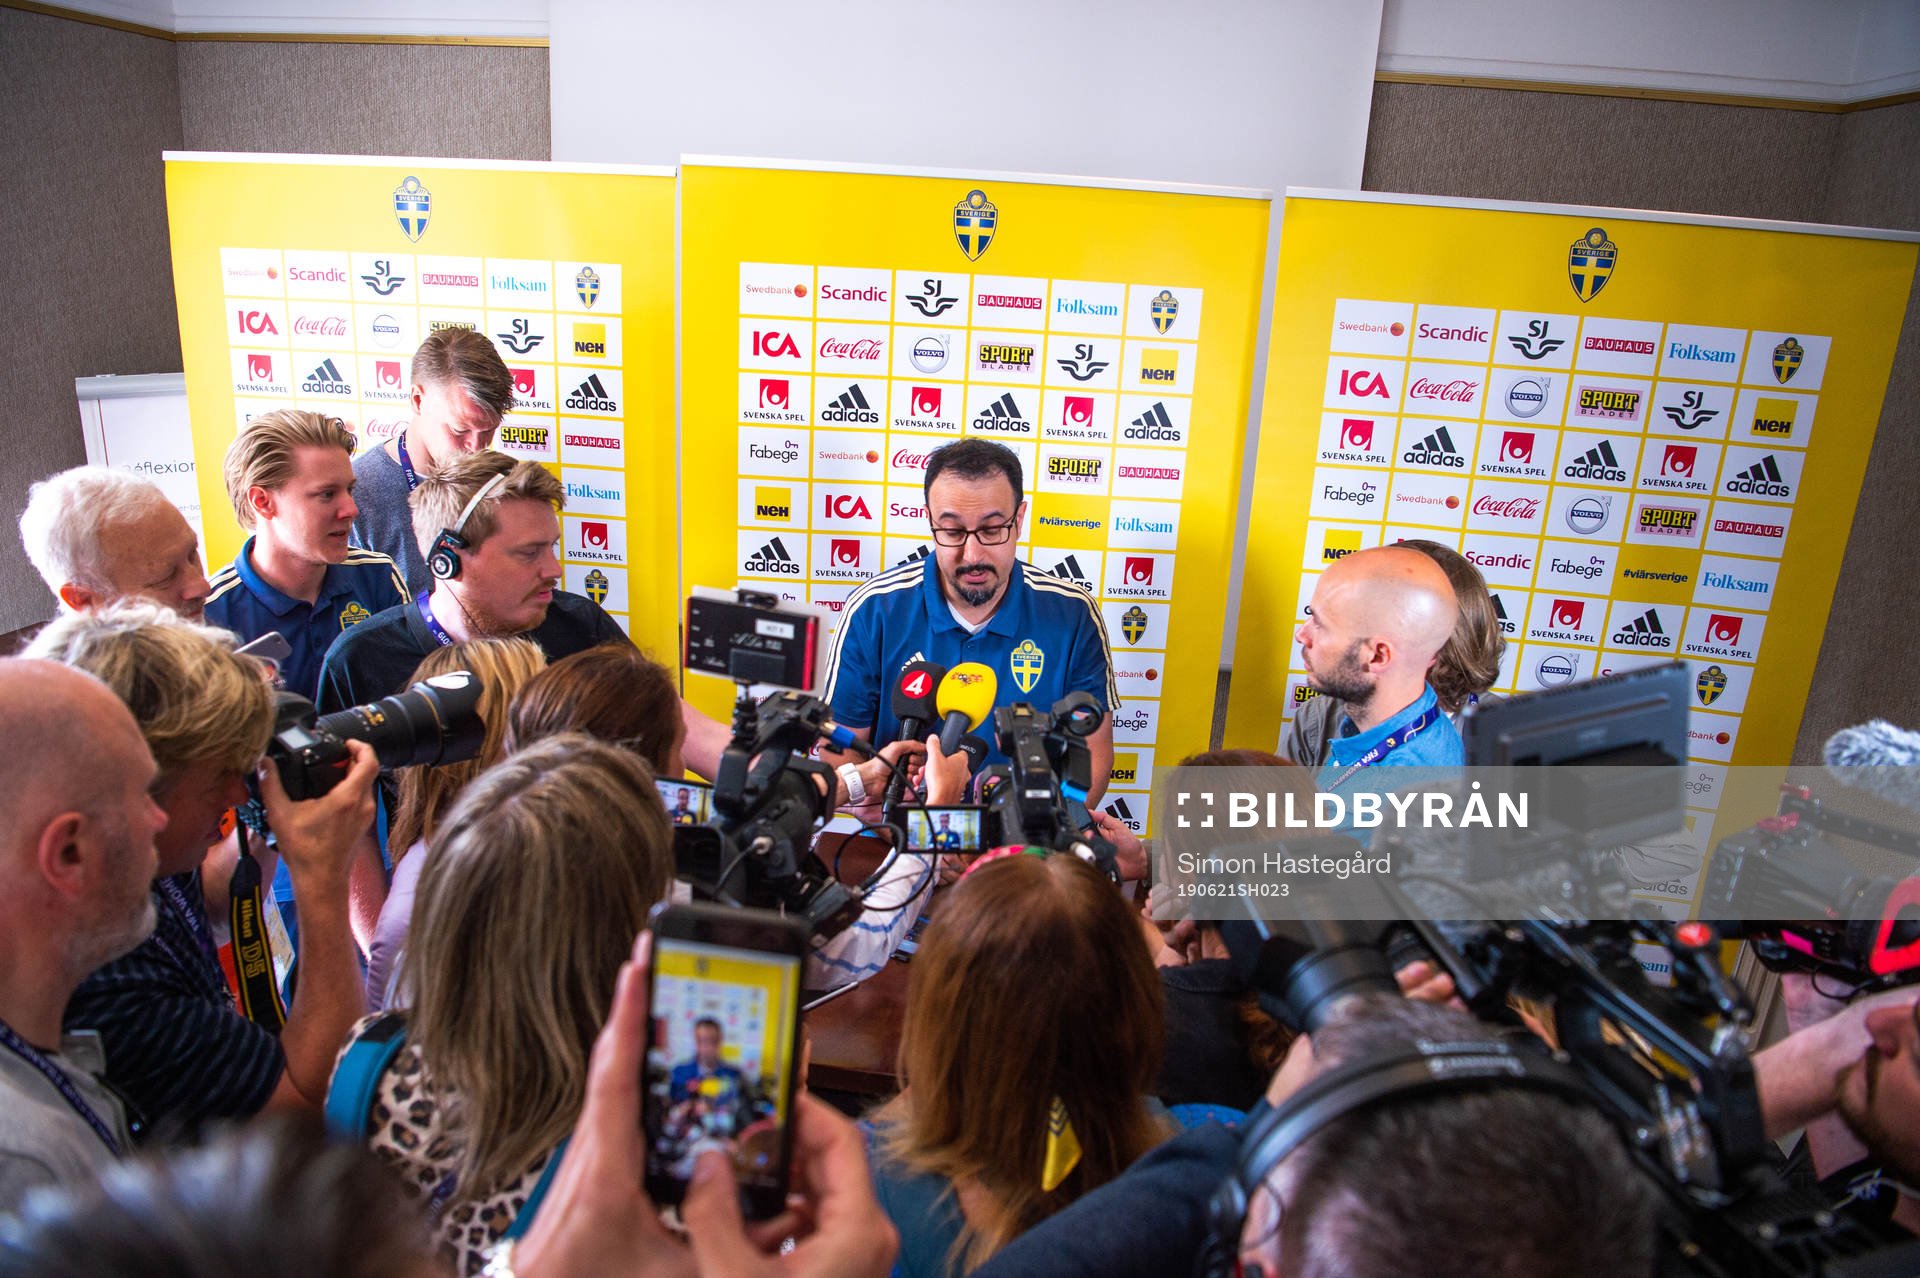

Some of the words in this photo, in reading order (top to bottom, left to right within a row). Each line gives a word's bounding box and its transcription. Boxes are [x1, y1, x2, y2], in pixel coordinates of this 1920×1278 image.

[290, 267, 346, 282] Scandic
[374, 261, 390, 276] SJ
[423, 274, 478, 286] BAUHAUS
[492, 275, 547, 292] Folksam
[746, 285, 792, 295] Swedbank
[822, 285, 887, 302] Scandic
[924, 279, 942, 297] SJ
[978, 295, 1041, 309] BAUHAUS
[1057, 298, 1117, 316] Folksam
[238, 310, 278, 335] ICA
[294, 316, 348, 336] Coca-Cola
[512, 319, 528, 335] SJ
[1340, 322, 1388, 333] Swedbank
[1528, 320, 1549, 339] SJ
[1419, 323, 1488, 343] Scandic
[753, 331, 801, 358] ICA
[820, 337, 885, 360] Coca-Cola
[1585, 337, 1655, 354] BAUHAUS
[980, 345, 1033, 364] SPORT
[1075, 344, 1094, 362] SJ
[1669, 343, 1736, 363] Folksam
[237, 383, 269, 392] SVENSKA
[302, 381, 351, 394] adidas
[1339, 369, 1390, 398] ICA
[1410, 378, 1480, 402] Coca-Cola
[364, 390, 397, 399] SVENSKA
[1581, 390, 1639, 412] SPORT
[1683, 391, 1704, 409] SJ
[566, 398, 616, 411] adidas
[744, 412, 782, 420] SVENSKA
[822, 408, 879, 423] adidas
[1581, 409, 1634, 418] BLADET
[895, 419, 933, 429] SVENSKA
[936, 422, 956, 430] SPEL
[973, 417, 1030, 432] adidas
[501, 427, 548, 445] SPORT
[1046, 429, 1085, 438] SVENSKA
[1124, 426, 1181, 441] adidas
[565, 435, 620, 449] BAUHAUS
[750, 444, 798, 463] Fabege
[820, 451, 864, 461] Swedbank
[1322, 452, 1362, 462] SVENSKA
[1365, 454, 1386, 463] SPEL
[1404, 451, 1464, 468] adidas
[1049, 457, 1100, 477] SPORT
[1119, 466, 1180, 480] BAUHAUS
[1481, 464, 1522, 475] SVENSKA
[1525, 467, 1546, 476] SPEL
[1564, 464, 1626, 482] adidas
[1050, 475, 1098, 483] BLADET
[1642, 479, 1683, 488] SVENSKA
[1685, 481, 1708, 490] SPEL
[567, 484, 620, 500] Folksam
[1727, 479, 1789, 497] adidas
[1324, 486, 1374, 506] Fabege
[1396, 493, 1443, 506] Swedbank
[825, 495, 872, 520] ICA
[1473, 495, 1543, 519] Coca-Cola
[1572, 510, 1602, 519] VOLVO
[1040, 516, 1100, 529] #viärsverige
[1115, 517, 1173, 533] Folksam
[1641, 508, 1696, 529] SPORT
[1641, 527, 1691, 535] BLADET
[1715, 520, 1784, 537] BAUHAUS
[568, 551, 603, 560] SVENSKA
[1465, 551, 1531, 569] Scandic
[745, 559, 799, 574] adidas
[1551, 558, 1603, 579] Fabege
[1624, 569, 1688, 583] #viärsverige
[1702, 572, 1769, 593] Folksam
[1108, 588, 1145, 596] SVENSKA
[1147, 589, 1167, 597] SPEL
[1531, 630, 1571, 640] SVENSKA
[1574, 634, 1595, 643] SPEL
[1613, 631, 1671, 648] adidas
[1686, 644, 1727, 656] SVENSKA
[1730, 649, 1753, 659] SPEL
[1113, 670, 1144, 678] edbank
[1542, 666, 1571, 674] VOLVO
[904, 672, 926, 695] 4
[1689, 730, 1714, 741] dbank
[1685, 781, 1711, 794] ege
[241, 900, 252, 938] Nikon
